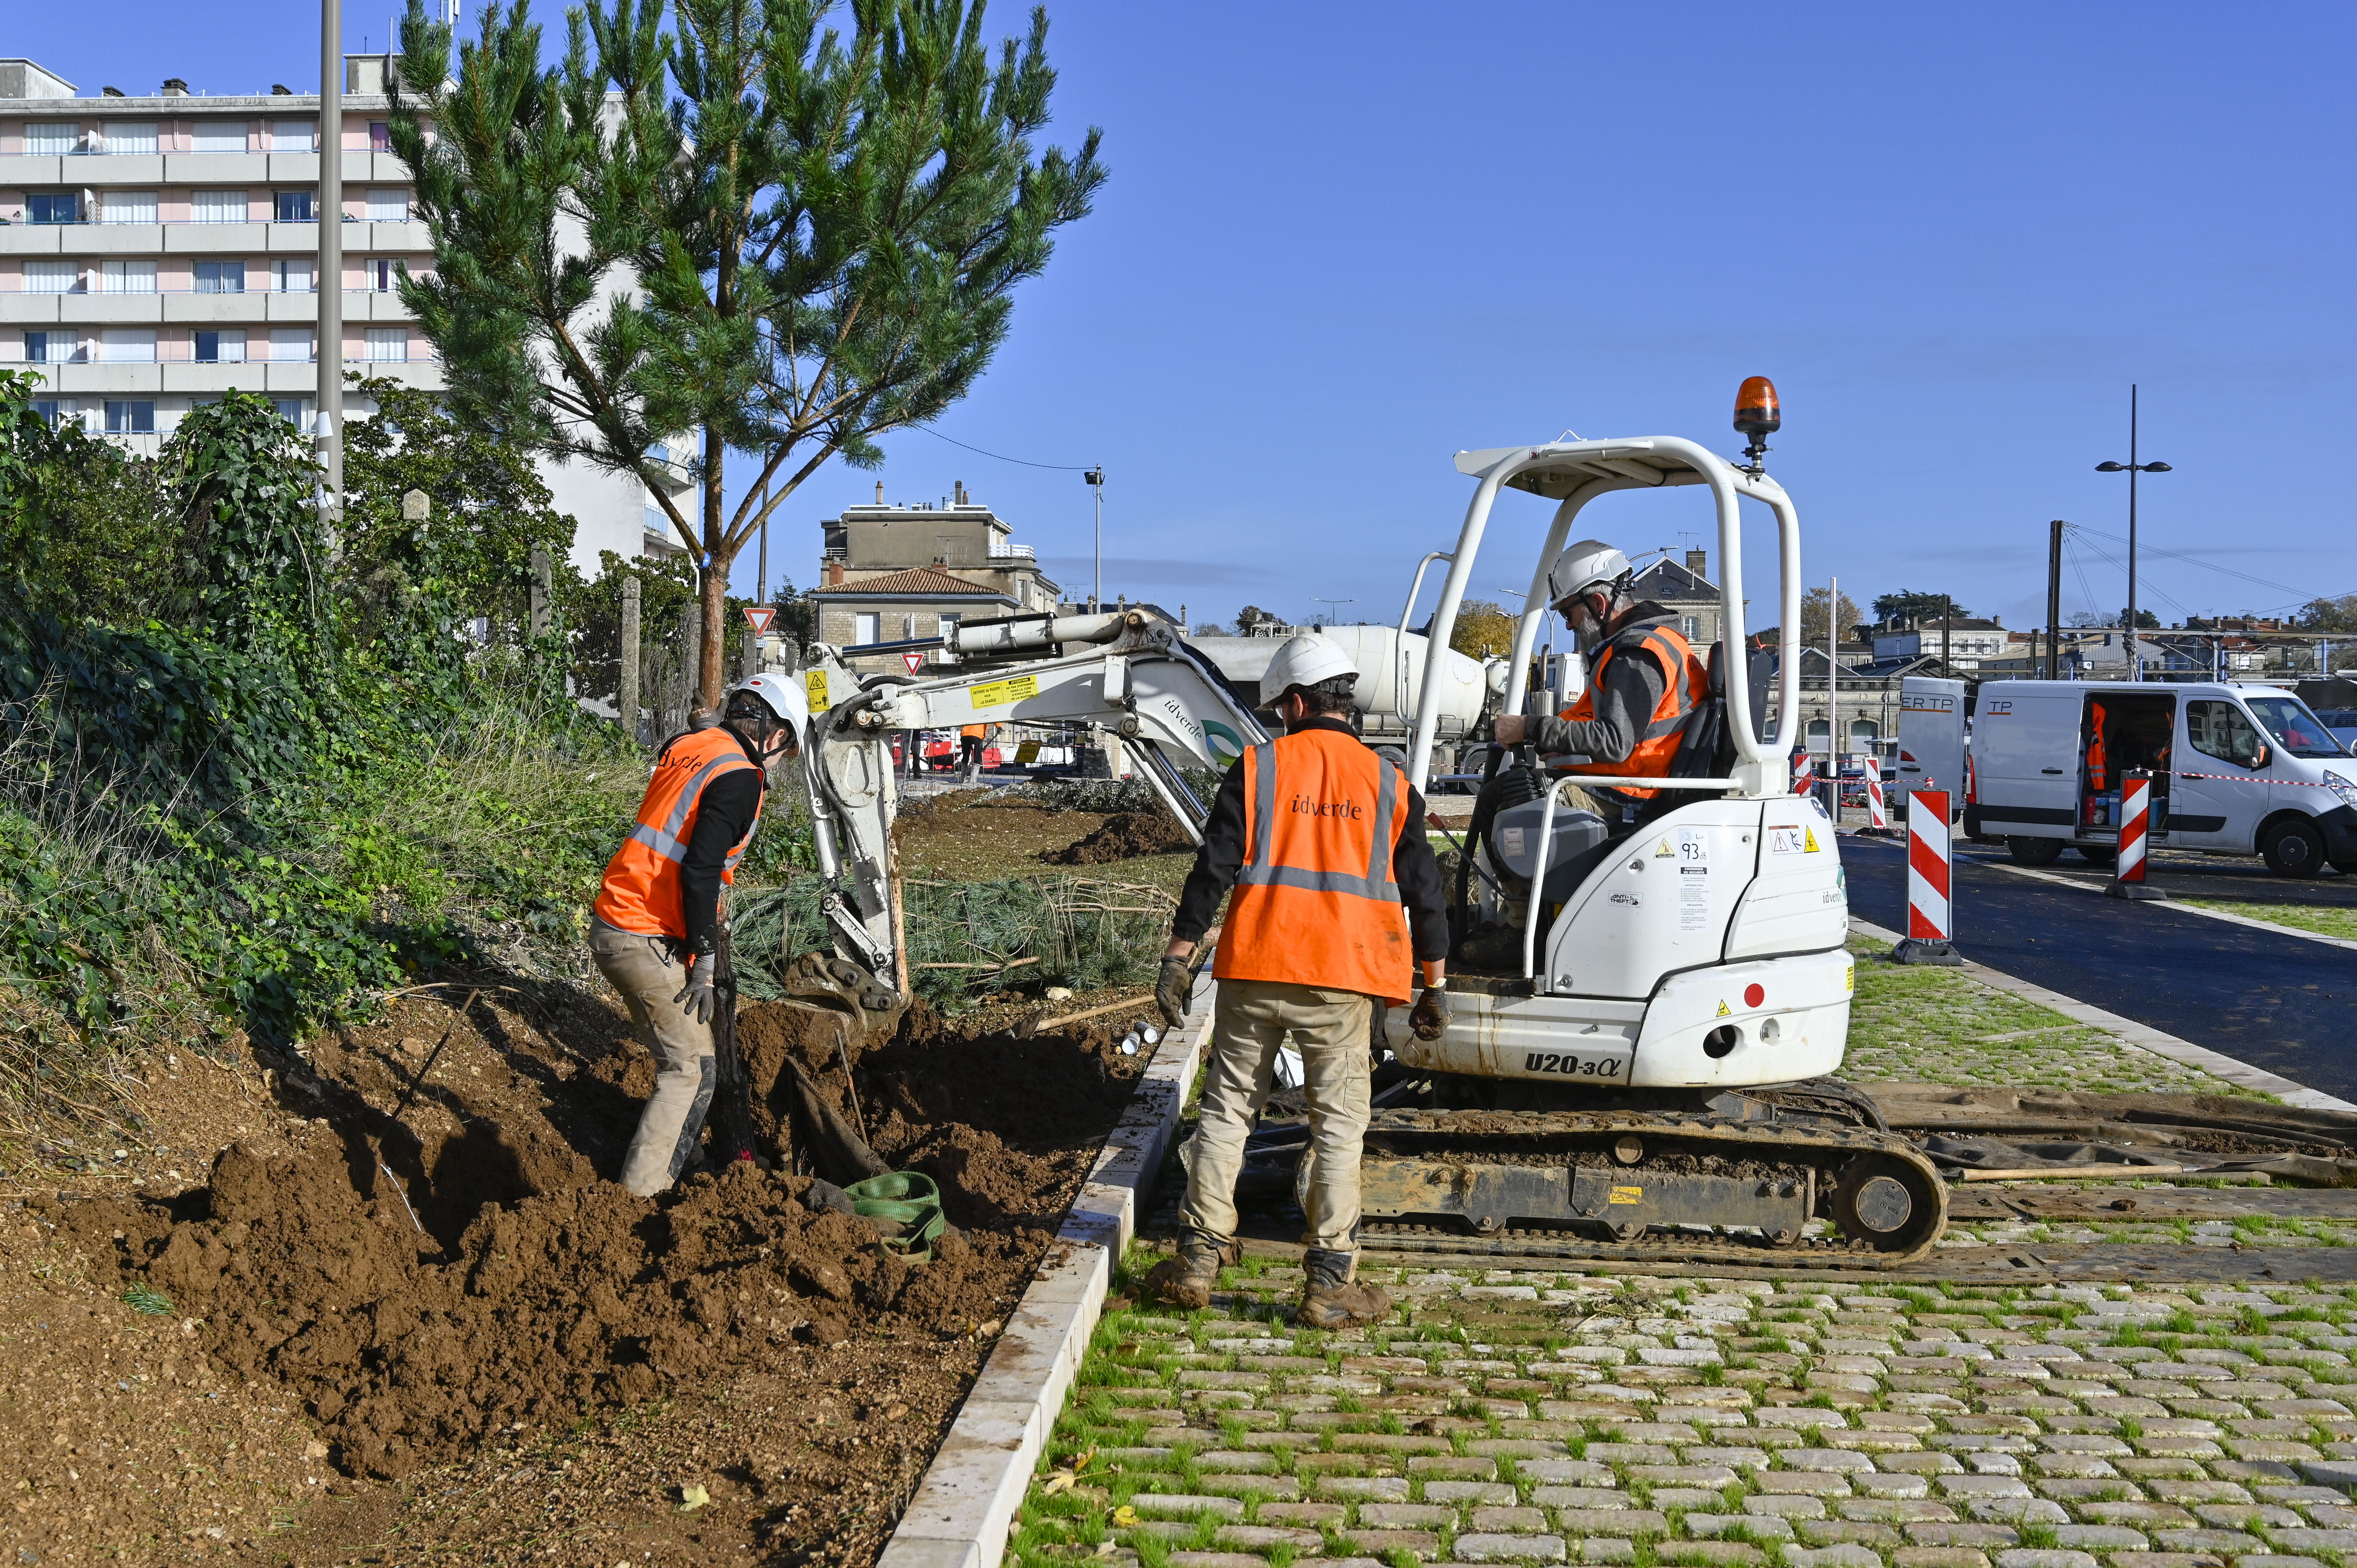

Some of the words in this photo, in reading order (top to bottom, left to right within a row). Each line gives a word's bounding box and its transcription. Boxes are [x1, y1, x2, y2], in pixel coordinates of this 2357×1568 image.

[1929, 699, 1953, 710] TP
[1990, 701, 2012, 712] TP
[1164, 700, 1201, 741] idverde
[1292, 795, 1361, 820] idverde
[1682, 843, 1699, 860] 93
[1823, 890, 1842, 904] idverde
